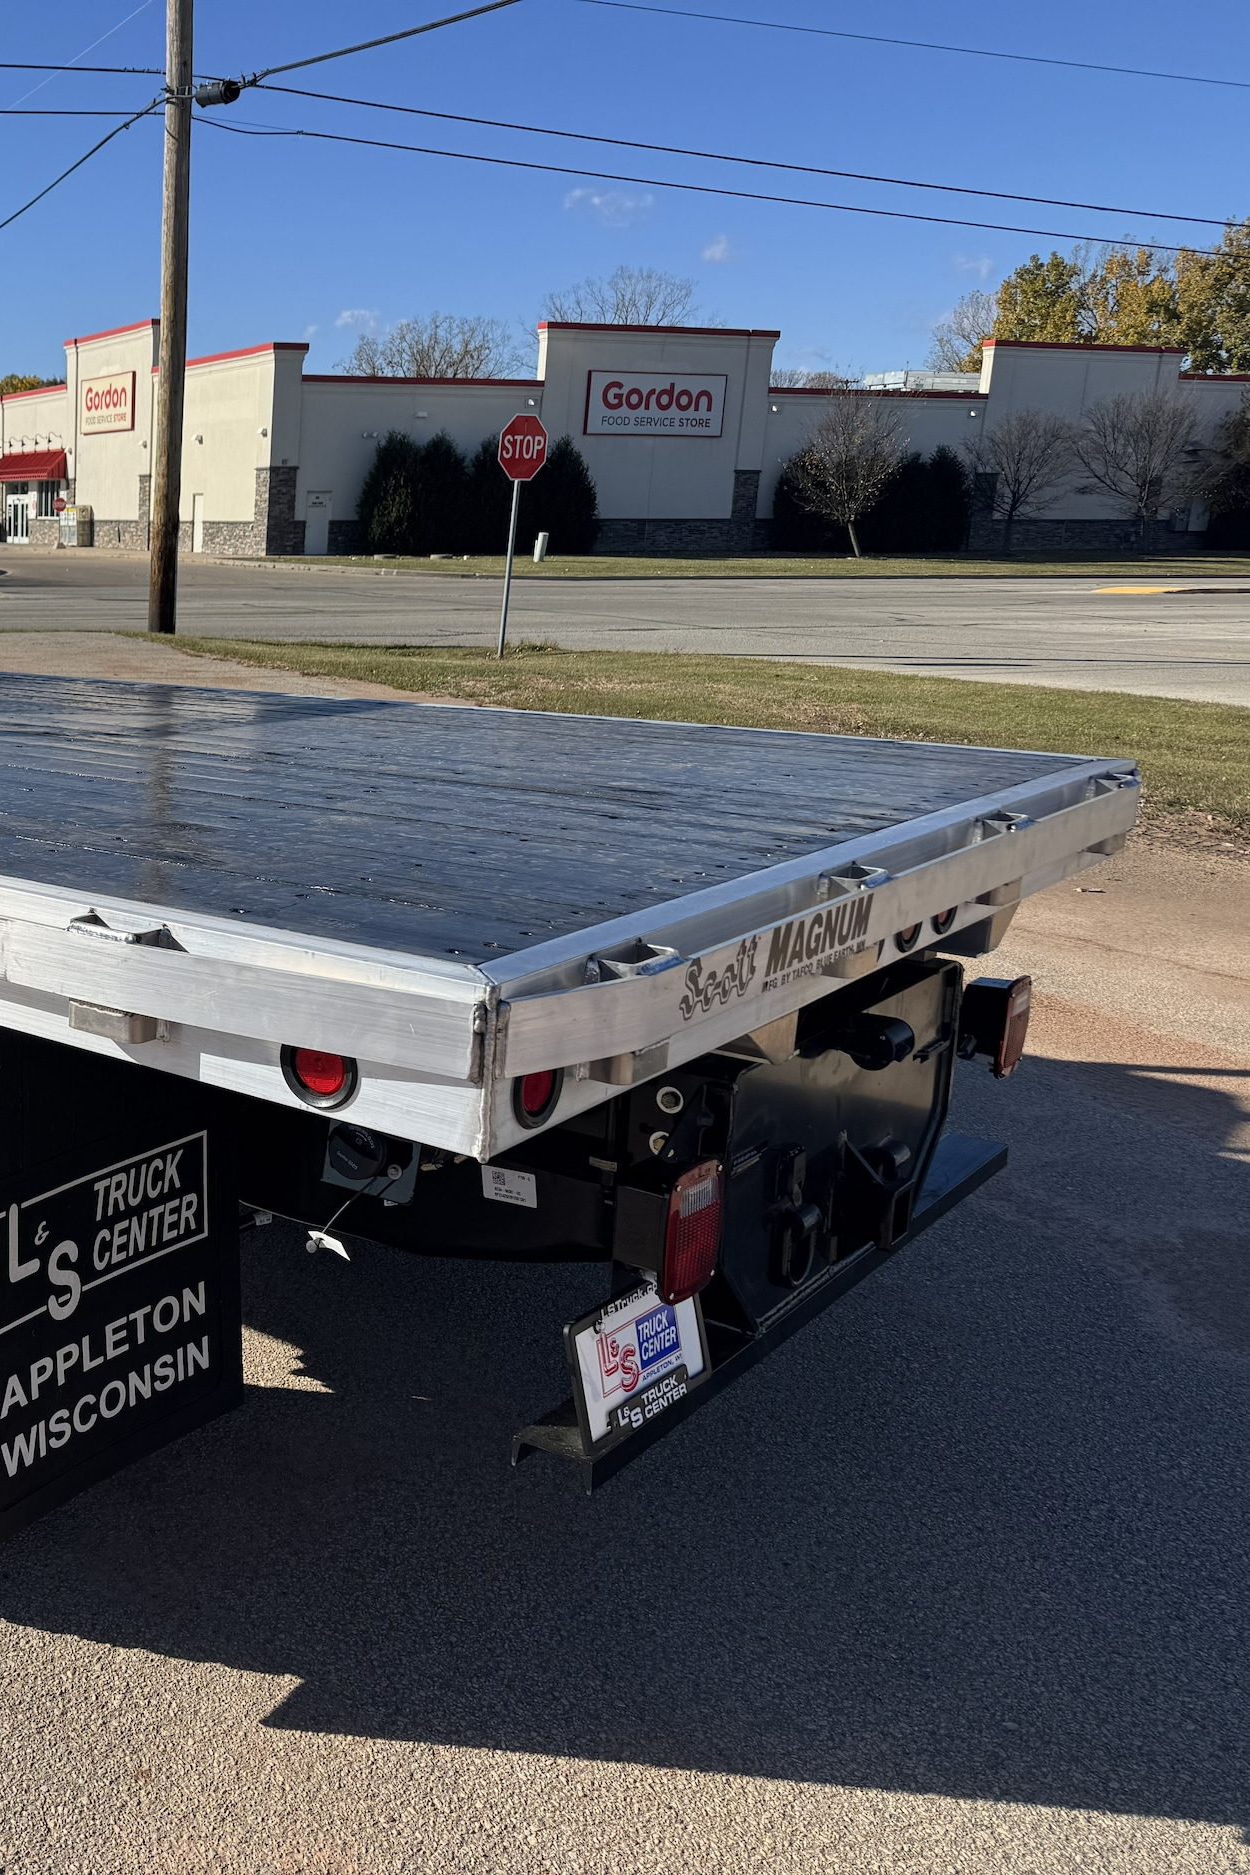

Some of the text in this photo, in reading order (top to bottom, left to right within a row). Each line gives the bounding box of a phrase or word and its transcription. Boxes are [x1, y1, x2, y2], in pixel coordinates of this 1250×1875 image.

[85, 383, 127, 412] Gordon
[602, 381, 713, 412] Gordon
[601, 416, 711, 428] FOOD SERVICE STORE
[502, 435, 545, 459] STOP
[679, 893, 874, 1021] Scott MAGNUM
[781, 972, 792, 986] BY
[816, 955, 833, 971] BLUE
[93, 1149, 183, 1221] TRUCK
[93, 1193, 198, 1270] CENTER
[638, 1310, 668, 1342] TRUCK
[0, 1281, 206, 1419] APPLETON
[641, 1326, 677, 1361] CENTER
[674, 1353, 683, 1364] WI
[641, 1374, 678, 1405] TRUCK
[645, 1383, 687, 1419] CENTER
[1, 1335, 209, 1478] WISCONSIN
